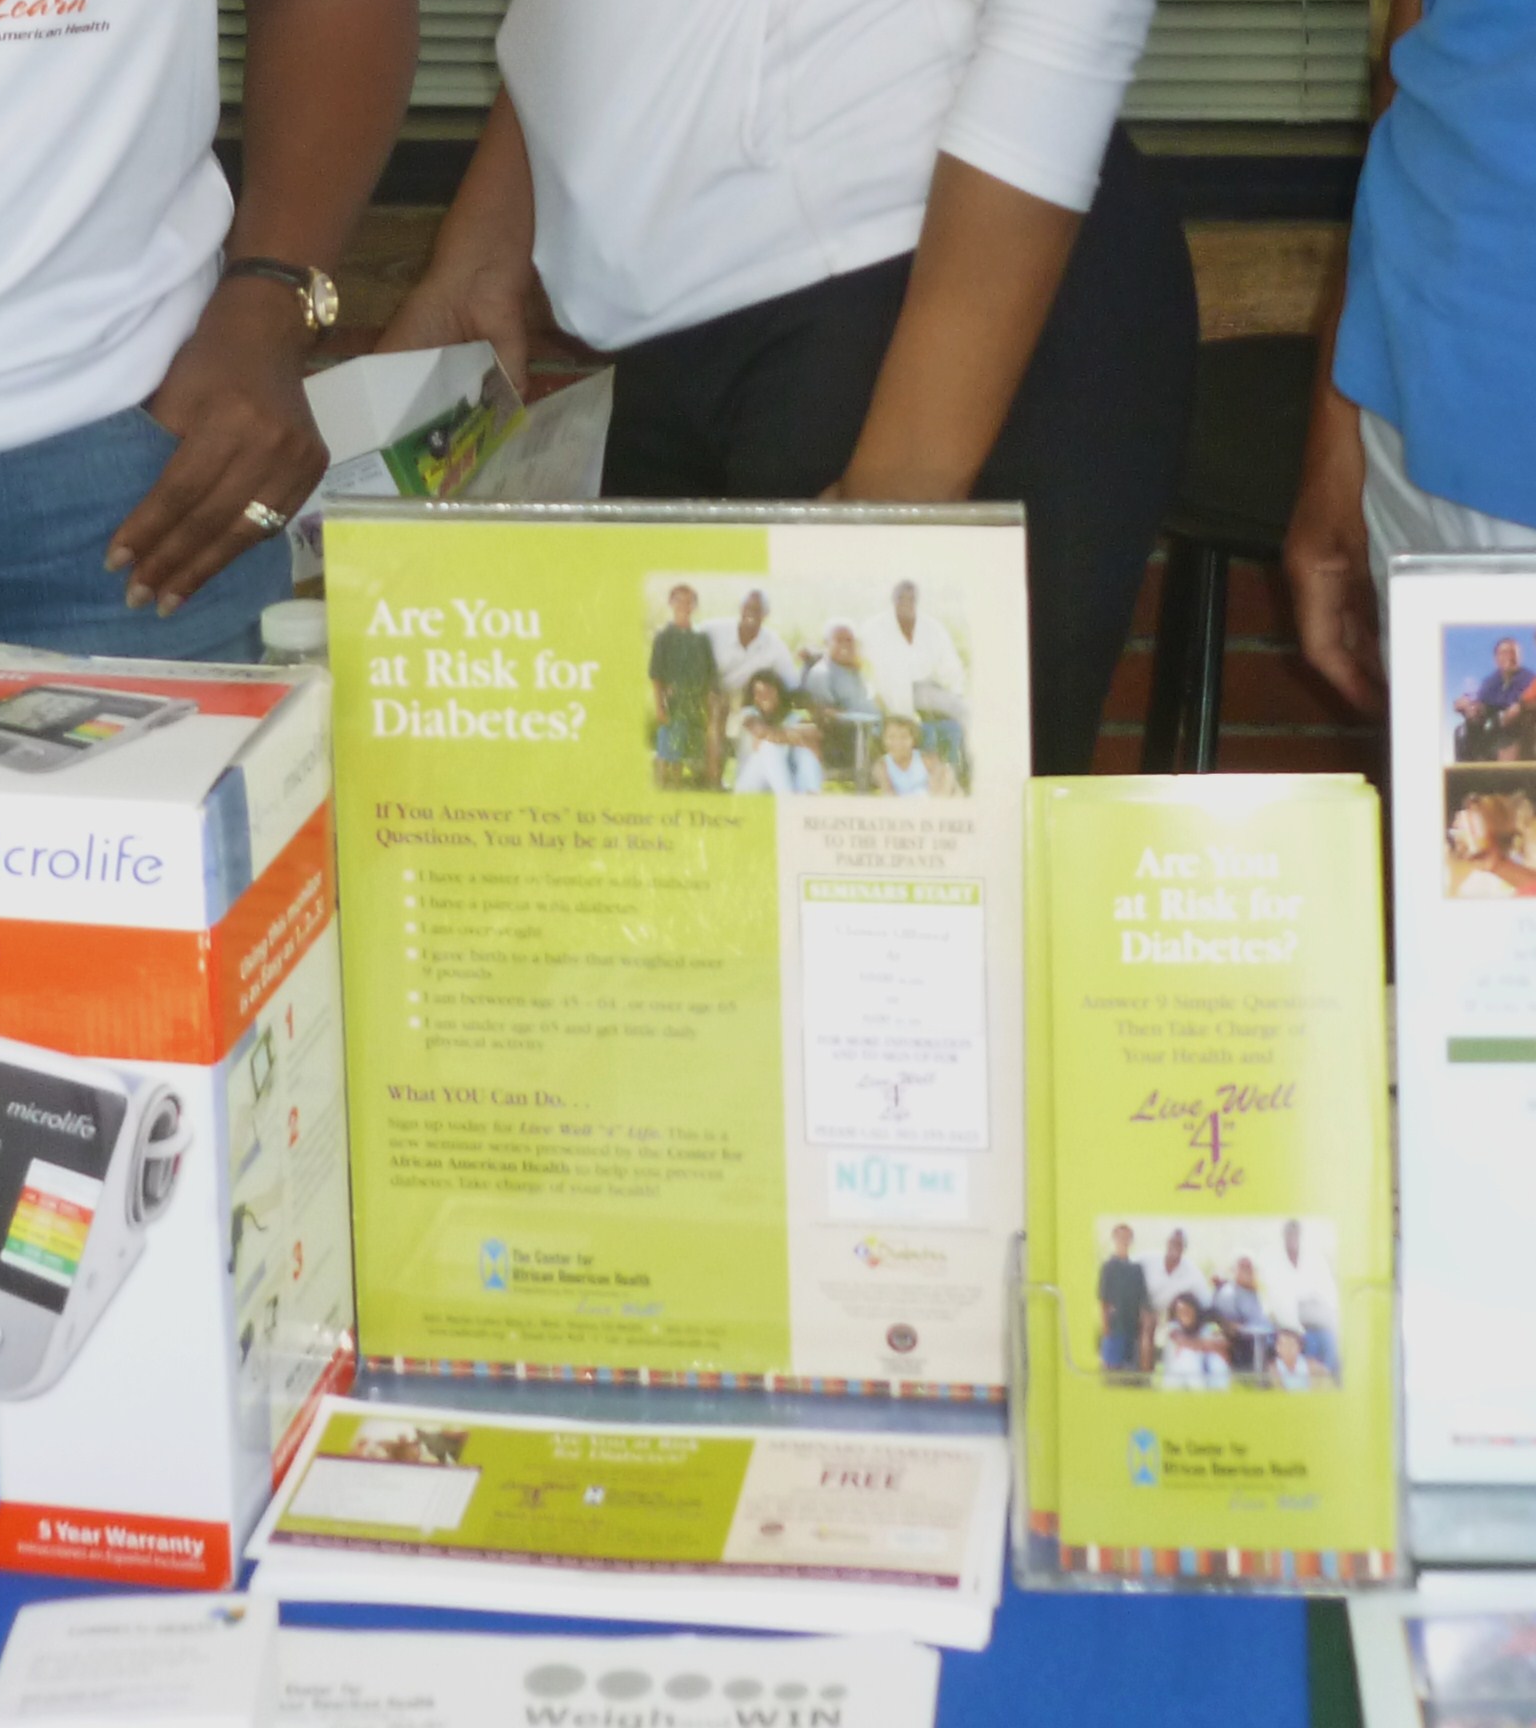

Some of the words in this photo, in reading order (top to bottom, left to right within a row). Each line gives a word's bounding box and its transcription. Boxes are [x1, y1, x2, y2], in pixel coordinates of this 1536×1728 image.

[65, 20, 110, 36] Health
[366, 599, 443, 638] Are
[450, 598, 541, 639] You
[370, 655, 410, 687] at
[425, 649, 517, 689] Risk
[534, 649, 599, 690] for
[371, 698, 586, 741] Diabetes?
[374, 802, 391, 820] If
[394, 802, 435, 822] You
[441, 804, 513, 823] Answer
[576, 809, 597, 826] to
[602, 809, 656, 828] Some
[803, 815, 915, 833] REGISTRATION
[374, 824, 478, 851] Questions,
[483, 828, 523, 848] You
[528, 830, 566, 853] May
[572, 831, 597, 851] be
[1133, 847, 1200, 880] Are
[1207, 847, 1281, 881] You
[1112, 892, 1148, 922] at
[1159, 888, 1239, 923] Risk
[1249, 888, 1304, 923] for
[1119, 929, 1299, 966] Diabetes?
[386, 1084, 437, 1104] What
[490, 1089, 529, 1108] Can
[1129, 1087, 1204, 1123] Live
[1215, 1082, 1296, 1117] Well
[6, 1100, 97, 1141] microlife
[1175, 1161, 1245, 1197] Life
[56, 1520, 100, 1546] Year
[104, 1525, 205, 1558] Warranty
